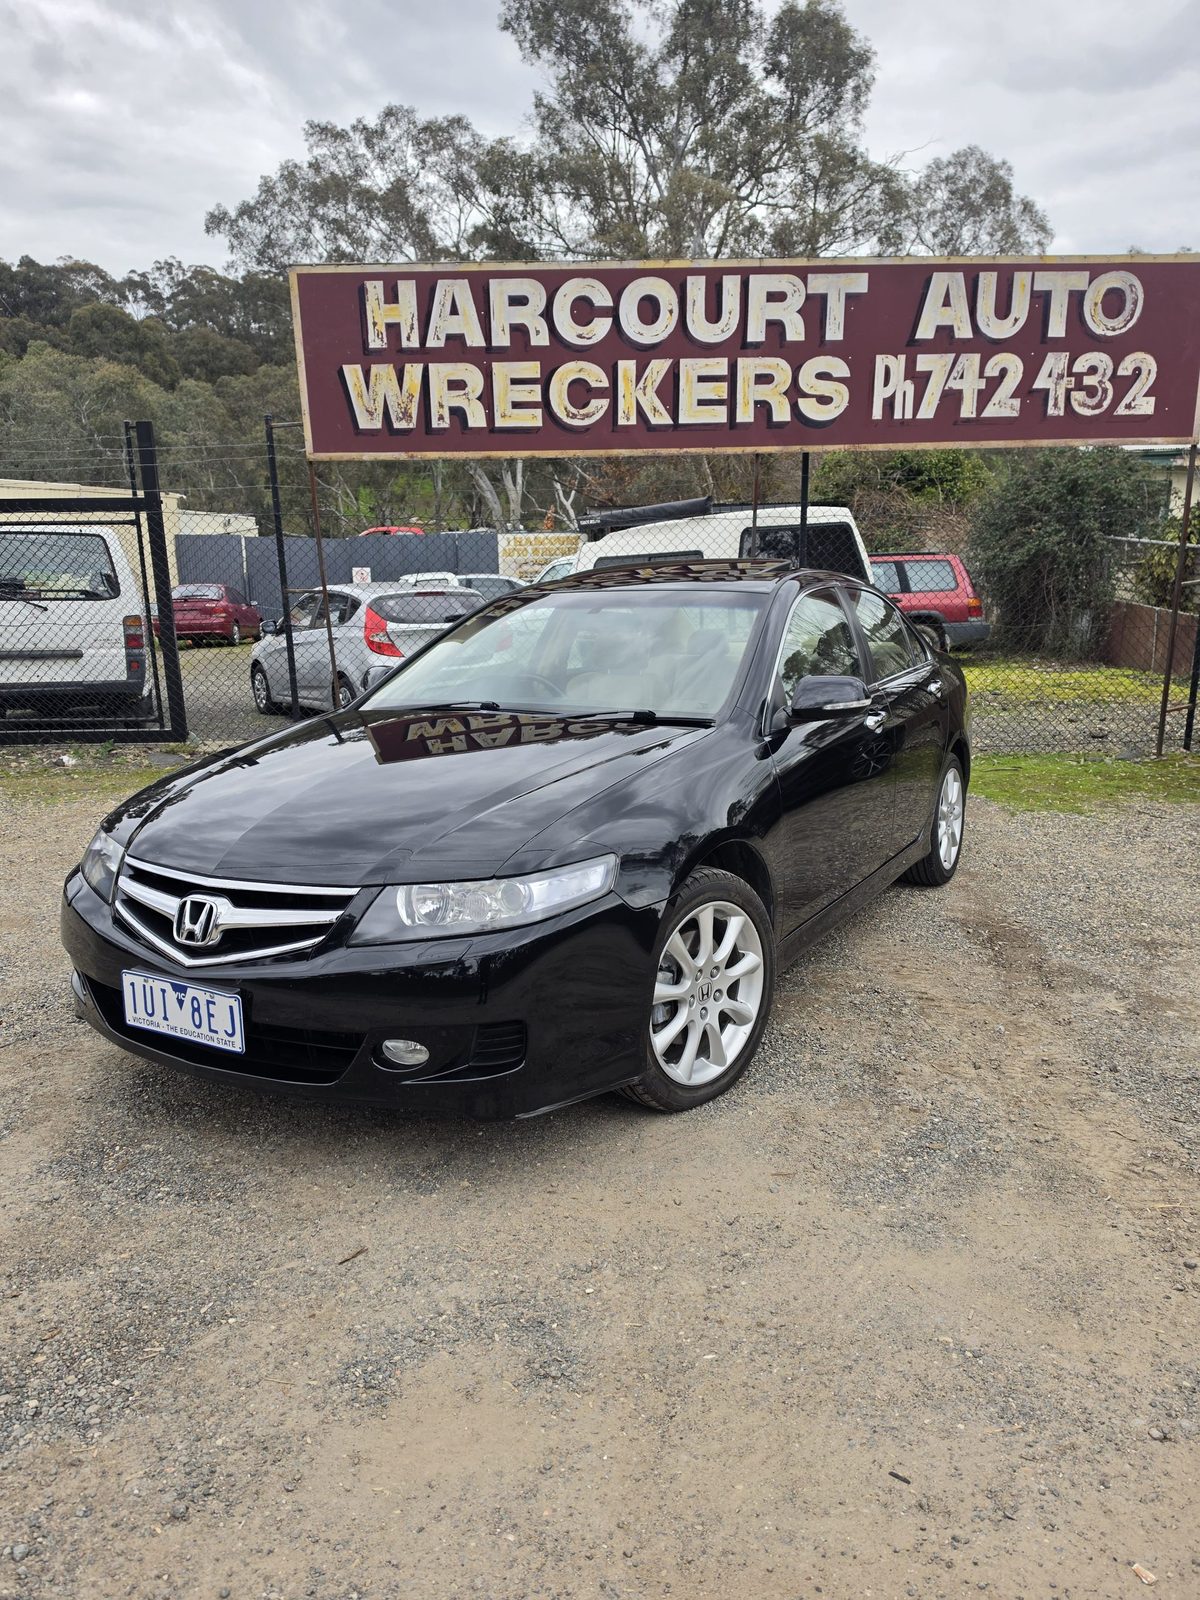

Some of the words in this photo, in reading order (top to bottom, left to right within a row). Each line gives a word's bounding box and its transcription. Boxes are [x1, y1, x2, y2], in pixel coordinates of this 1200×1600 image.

[363, 273, 869, 349] HARCOURT
[914, 270, 1145, 340] AUTO
[342, 355, 851, 430] WRECKERS
[132, 1016, 160, 1029] VICTORIA
[166, 1024, 178, 1033] THE
[180, 1027, 215, 1043] EDUCATION
[216, 1037, 236, 1048] STATE
